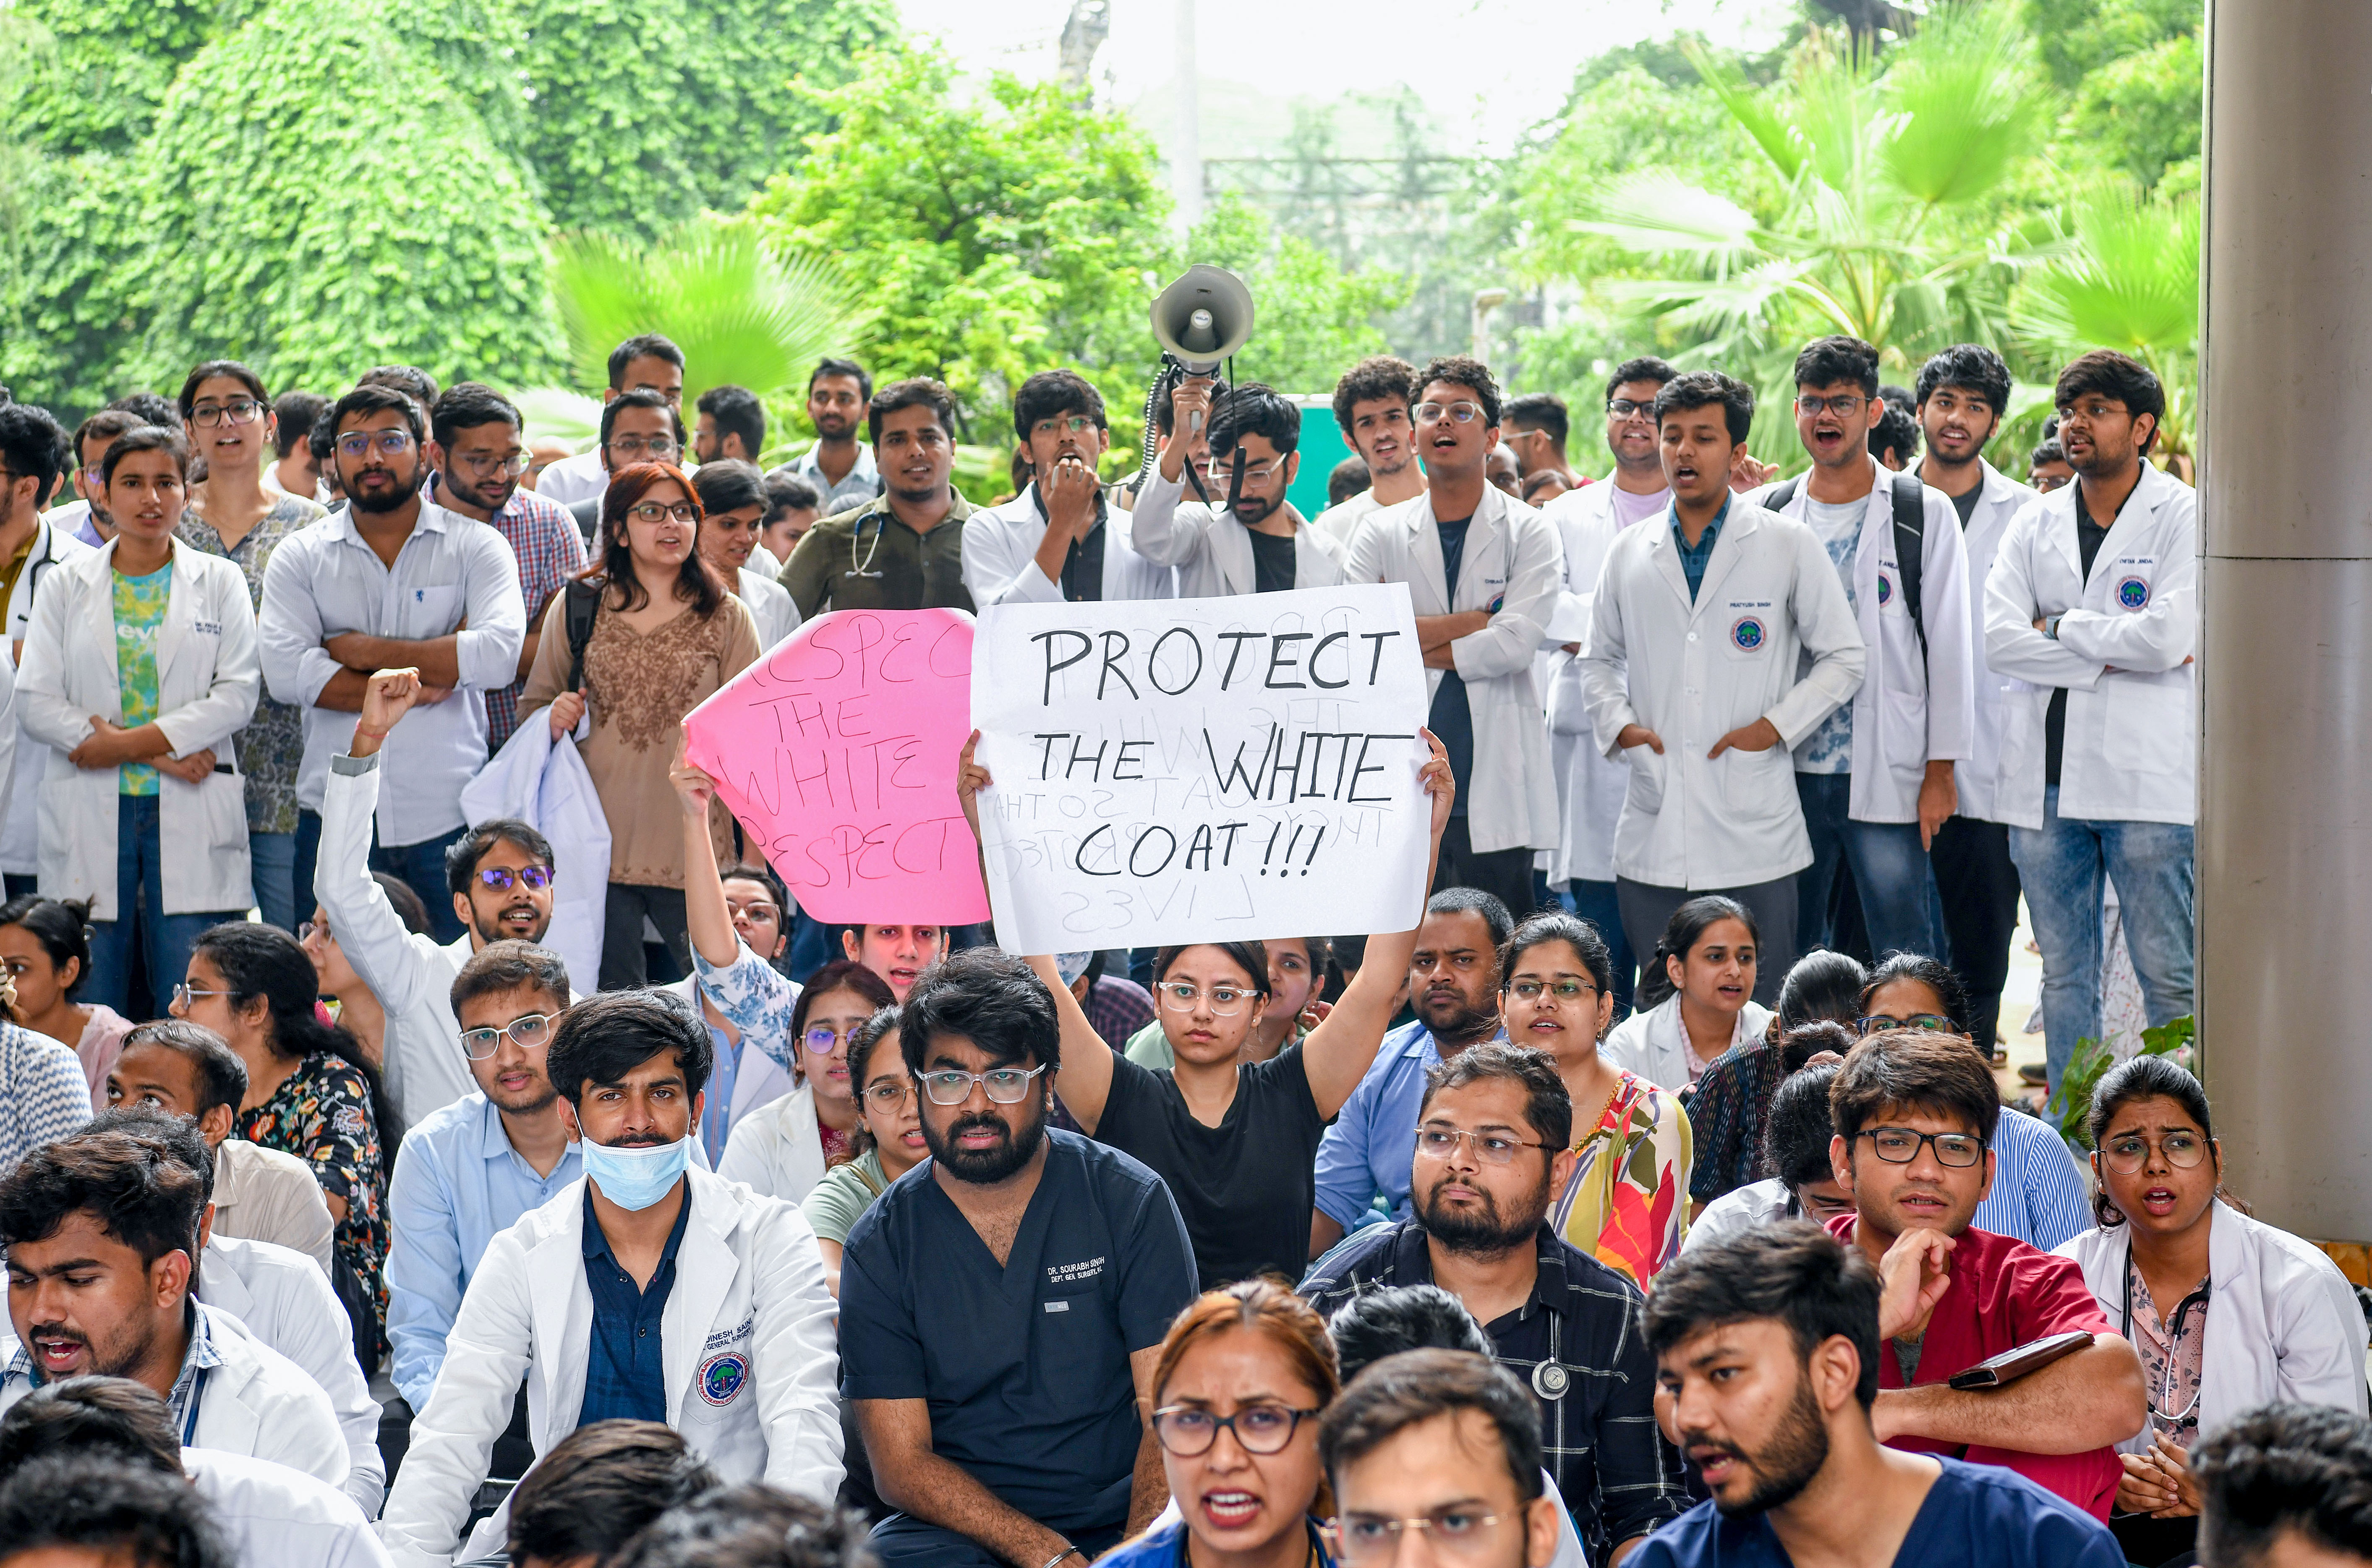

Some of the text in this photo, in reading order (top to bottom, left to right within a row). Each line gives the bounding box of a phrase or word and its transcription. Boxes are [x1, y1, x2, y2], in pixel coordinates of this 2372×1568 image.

[1030, 627, 1400, 706] PROTECT
[749, 693, 872, 742] THE
[717, 734, 927, 817] WHITE
[1034, 721, 1416, 803] THE WHITE
[1048, 1256, 1105, 1275] DR. SOURABH SINGH
[707, 1327, 751, 1350] GENERAL SURGERY
[737, 1317, 752, 1333] SAINI
